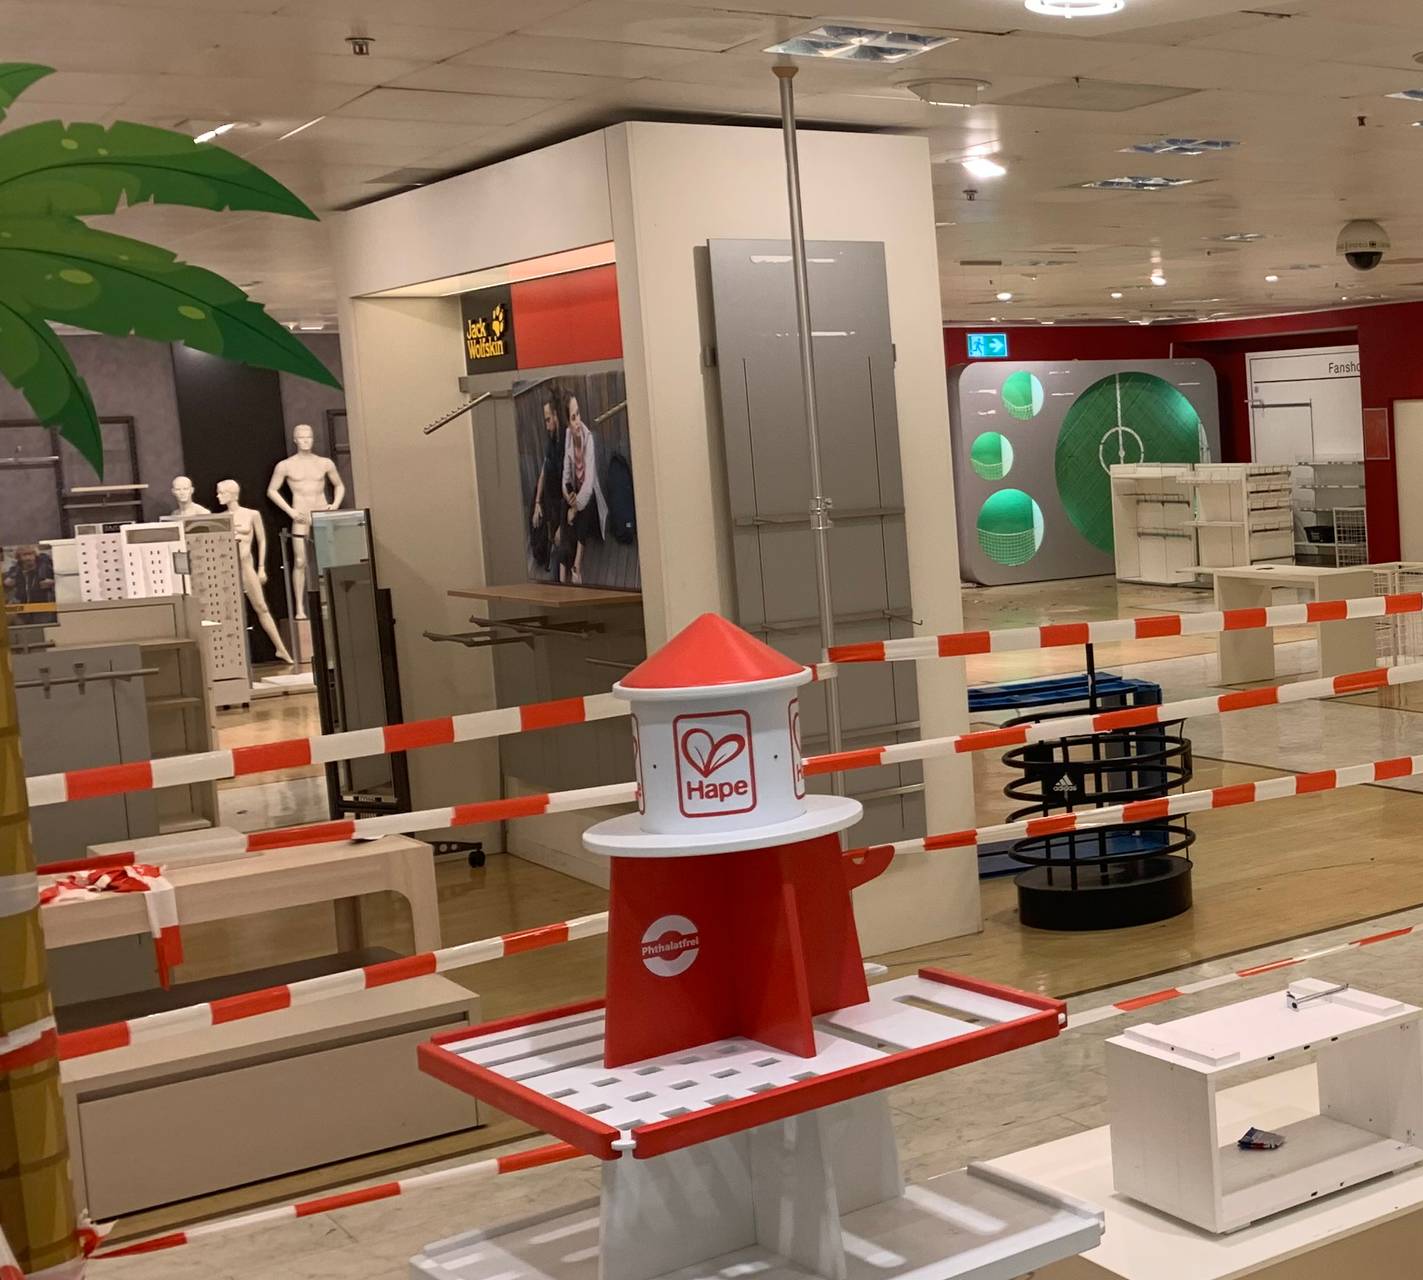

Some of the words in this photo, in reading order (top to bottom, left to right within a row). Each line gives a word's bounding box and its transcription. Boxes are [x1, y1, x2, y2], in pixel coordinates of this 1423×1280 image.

[466, 317, 487, 339] Jack
[467, 336, 504, 360] Wolfskin
[1328, 361, 1361, 374] Fansho
[686, 779, 749, 803] Hape
[641, 935, 699, 956] Phthalatfrei
